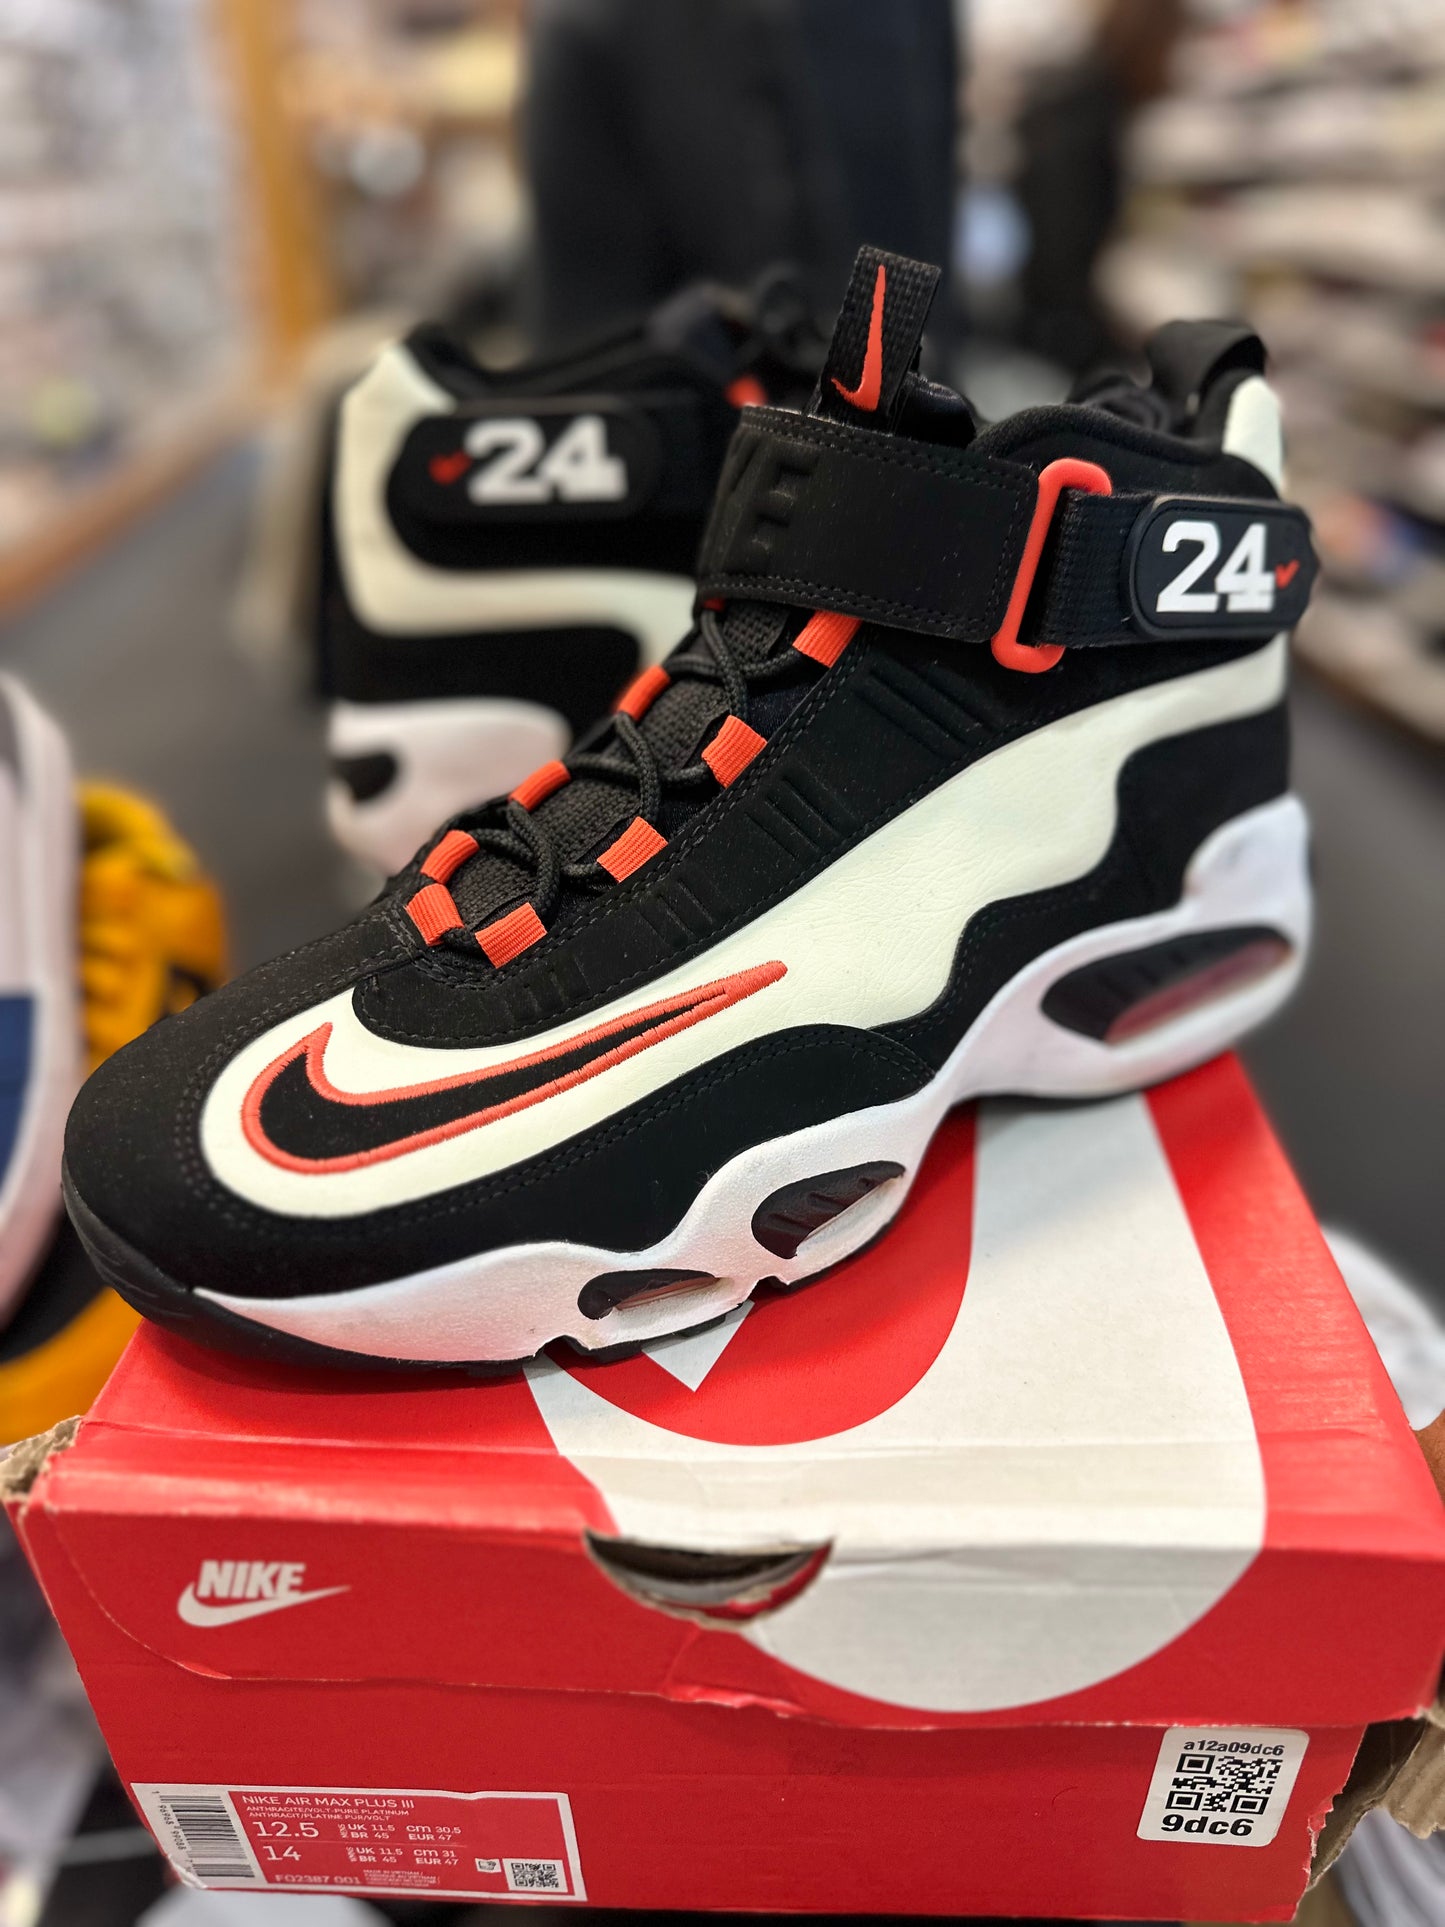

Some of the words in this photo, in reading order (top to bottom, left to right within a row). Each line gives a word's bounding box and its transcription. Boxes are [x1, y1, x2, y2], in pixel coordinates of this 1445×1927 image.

[464, 414, 629, 506] 24
[1155, 519, 1276, 613] 24
[197, 1560, 306, 1600] NIKE
[1183, 1739, 1285, 1756] a12a09dc6
[242, 1795, 281, 1805] NIKE
[285, 1797, 312, 1805] AIR
[314, 1797, 352, 1807] MAX
[354, 1798, 398, 1808] PLUS
[401, 1799, 414, 1808] III
[252, 1821, 319, 1838] 12.5
[348, 1823, 368, 1831] UK
[435, 1826, 461, 1834] 30.5
[1161, 1814, 1254, 1836] 9dc6
[263, 1846, 302, 1861] 14
